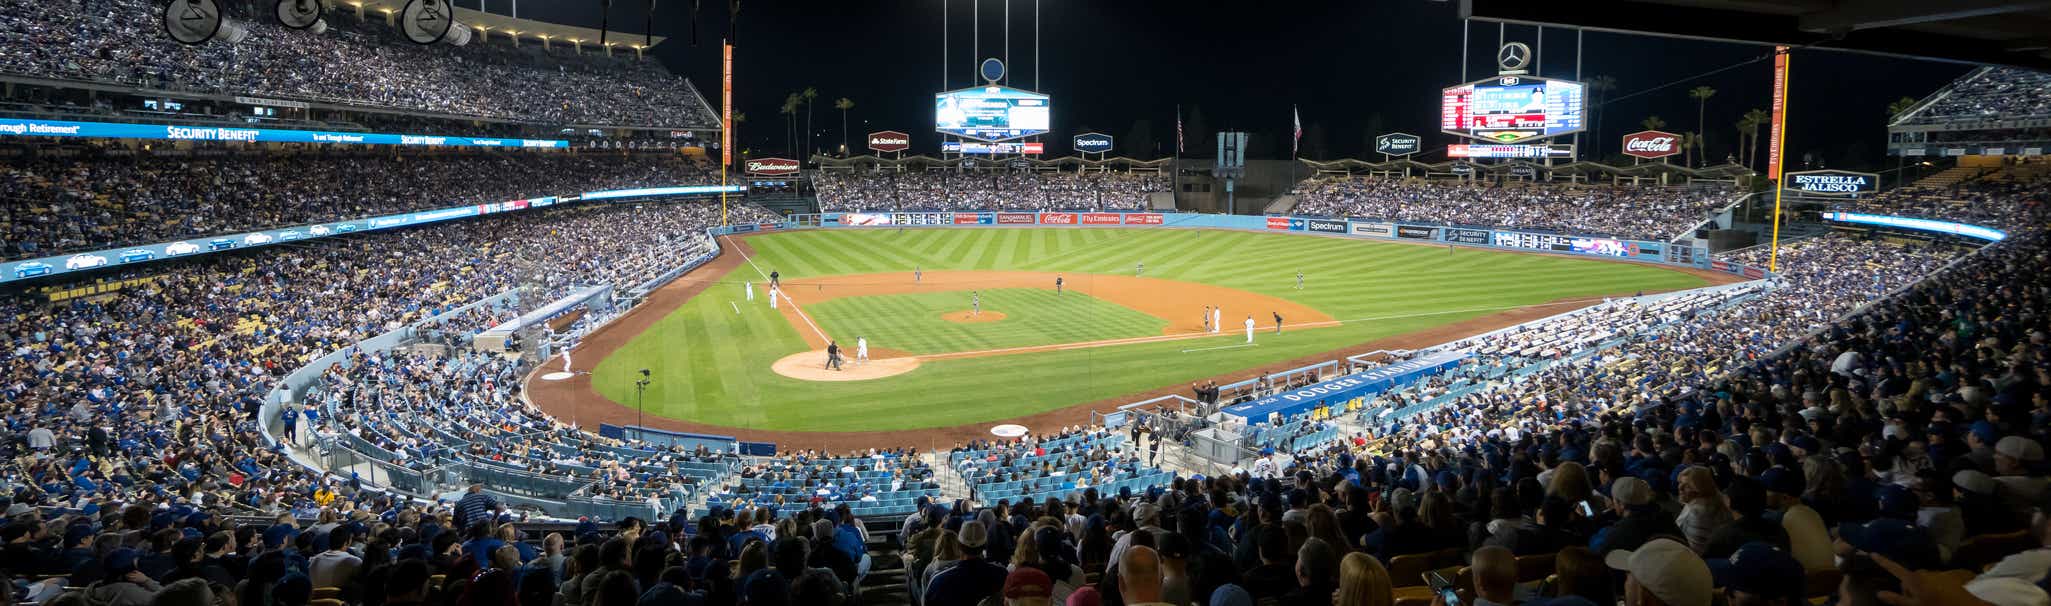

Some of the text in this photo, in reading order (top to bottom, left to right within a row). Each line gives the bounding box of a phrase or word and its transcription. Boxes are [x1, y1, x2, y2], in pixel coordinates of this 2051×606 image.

[29, 123, 77, 134] Retirement
[167, 126, 217, 139] SECURITY
[1077, 139, 1108, 147] Spectrum
[1795, 175, 1866, 185] ESTRELLA
[1801, 183, 1858, 192] JALISCO
[1310, 221, 1344, 231] Spectrum
[1283, 378, 1363, 401] DODGER
